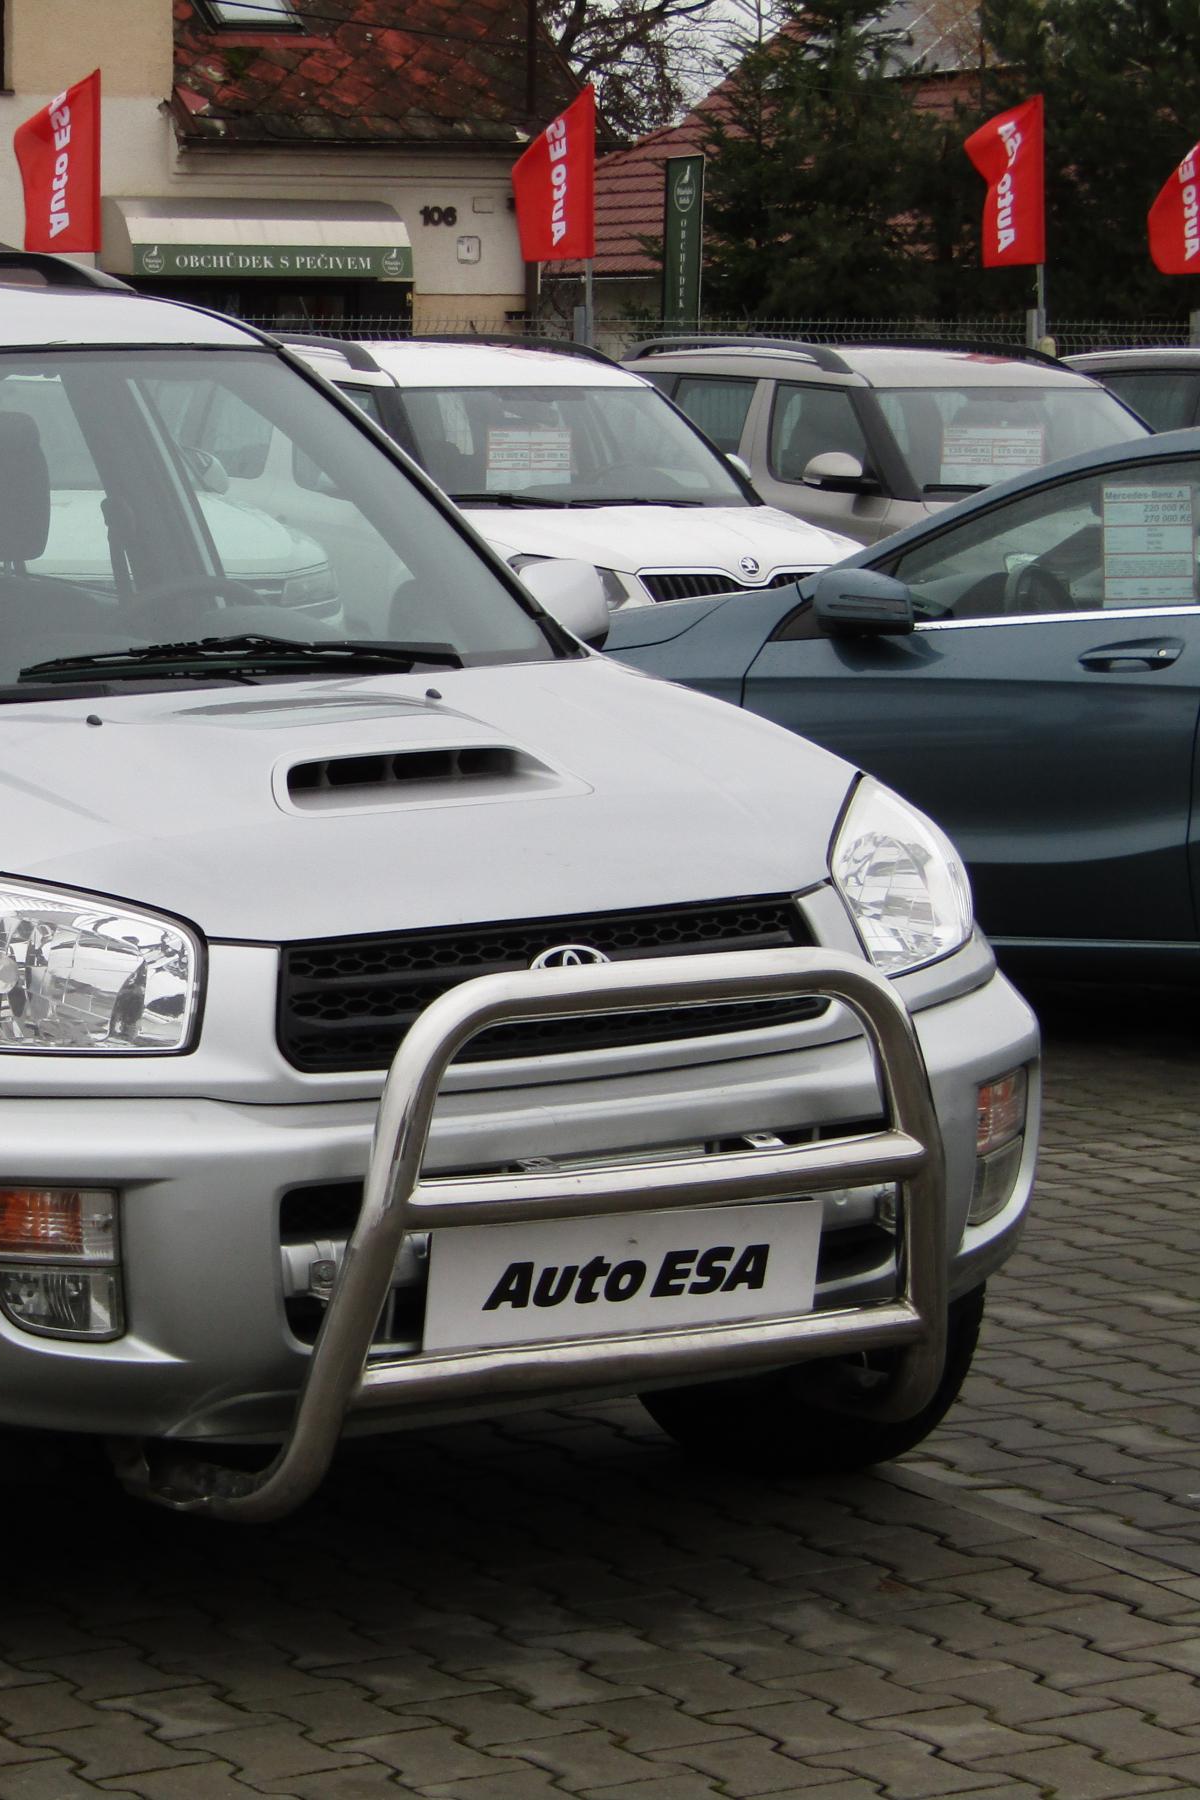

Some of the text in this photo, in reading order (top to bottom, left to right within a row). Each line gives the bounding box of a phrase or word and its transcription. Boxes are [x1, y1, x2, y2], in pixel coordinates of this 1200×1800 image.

[279, 255, 290, 269] S
[295, 253, 371, 270] PEČIVEM
[482, 1243, 770, 1311] Auto ESA
